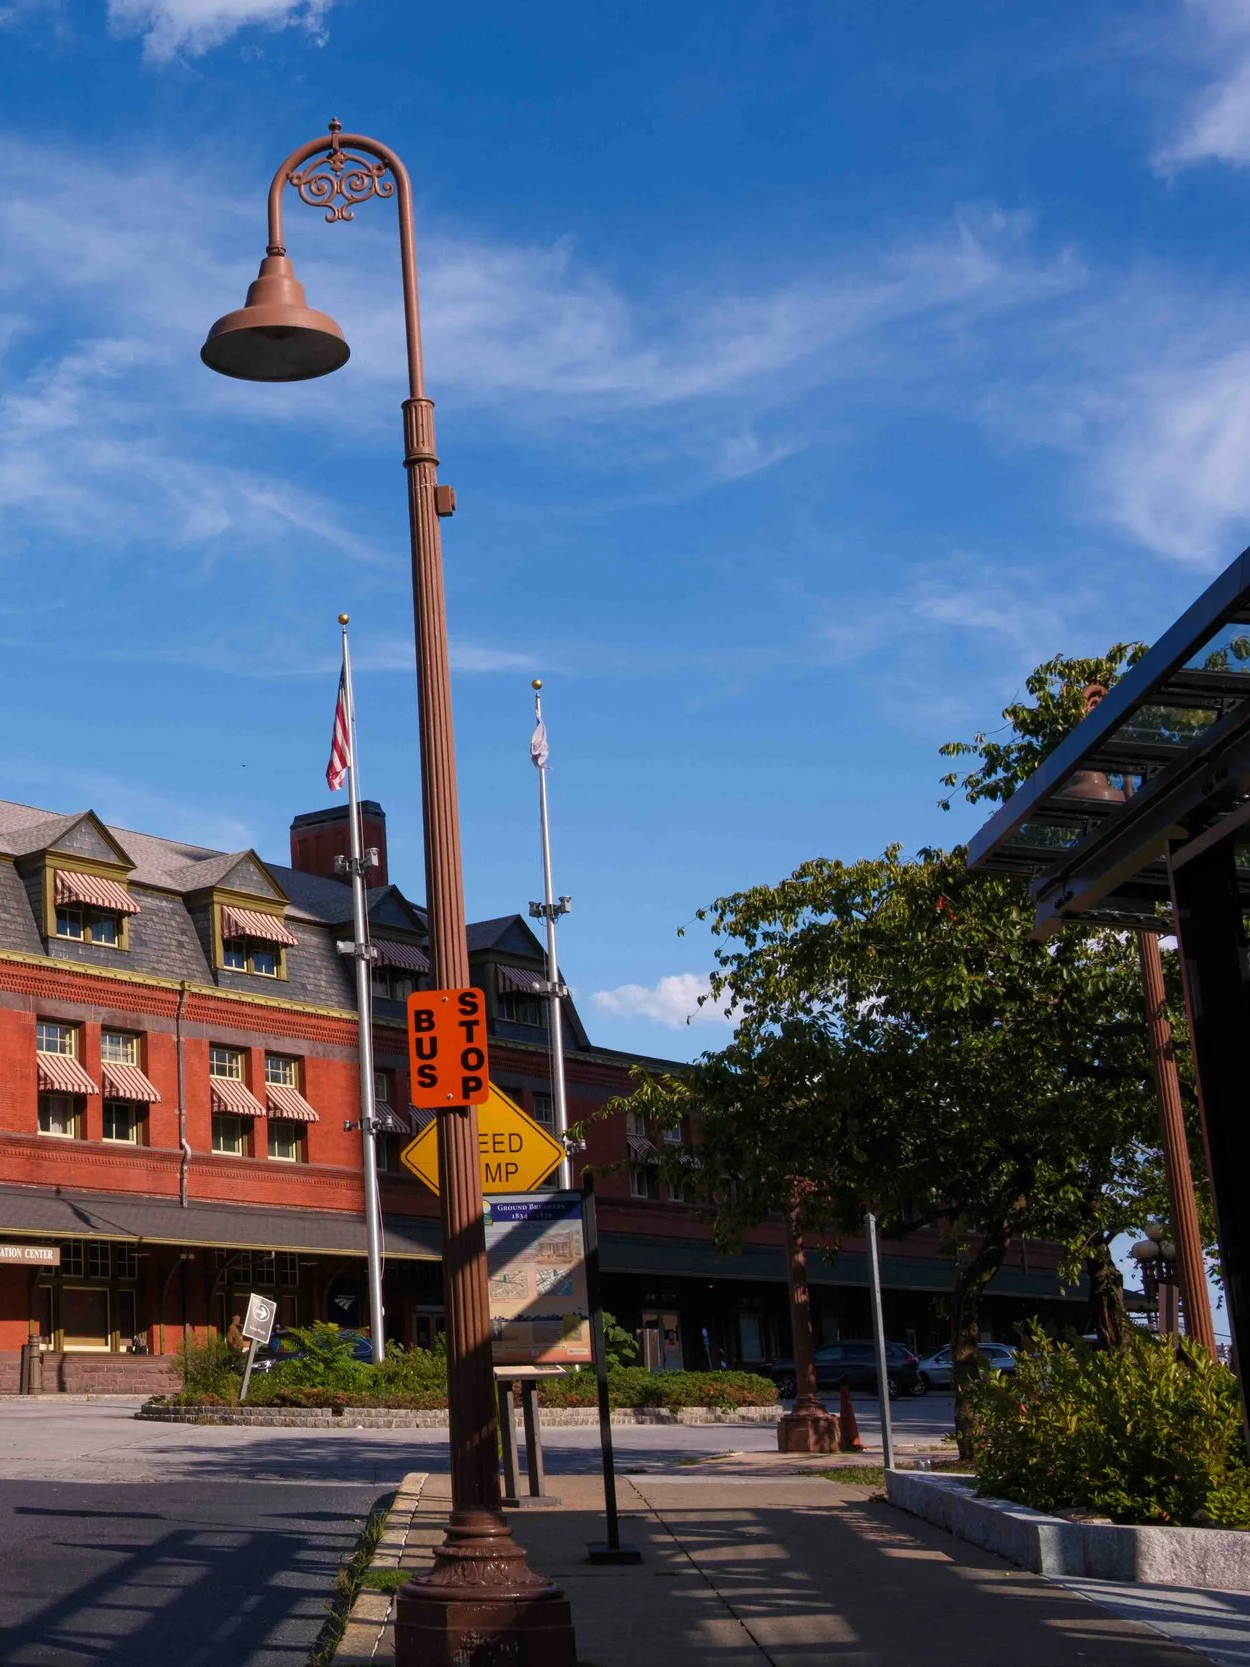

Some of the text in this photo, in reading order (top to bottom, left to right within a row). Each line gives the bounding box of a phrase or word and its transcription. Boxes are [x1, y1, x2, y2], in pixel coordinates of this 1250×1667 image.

[413, 1008, 438, 1089] BUS
[458, 991, 485, 1100] STOP
[478, 1133, 523, 1154] EED
[485, 1162, 519, 1183] MP
[25, 1248, 54, 1260] CENTER
